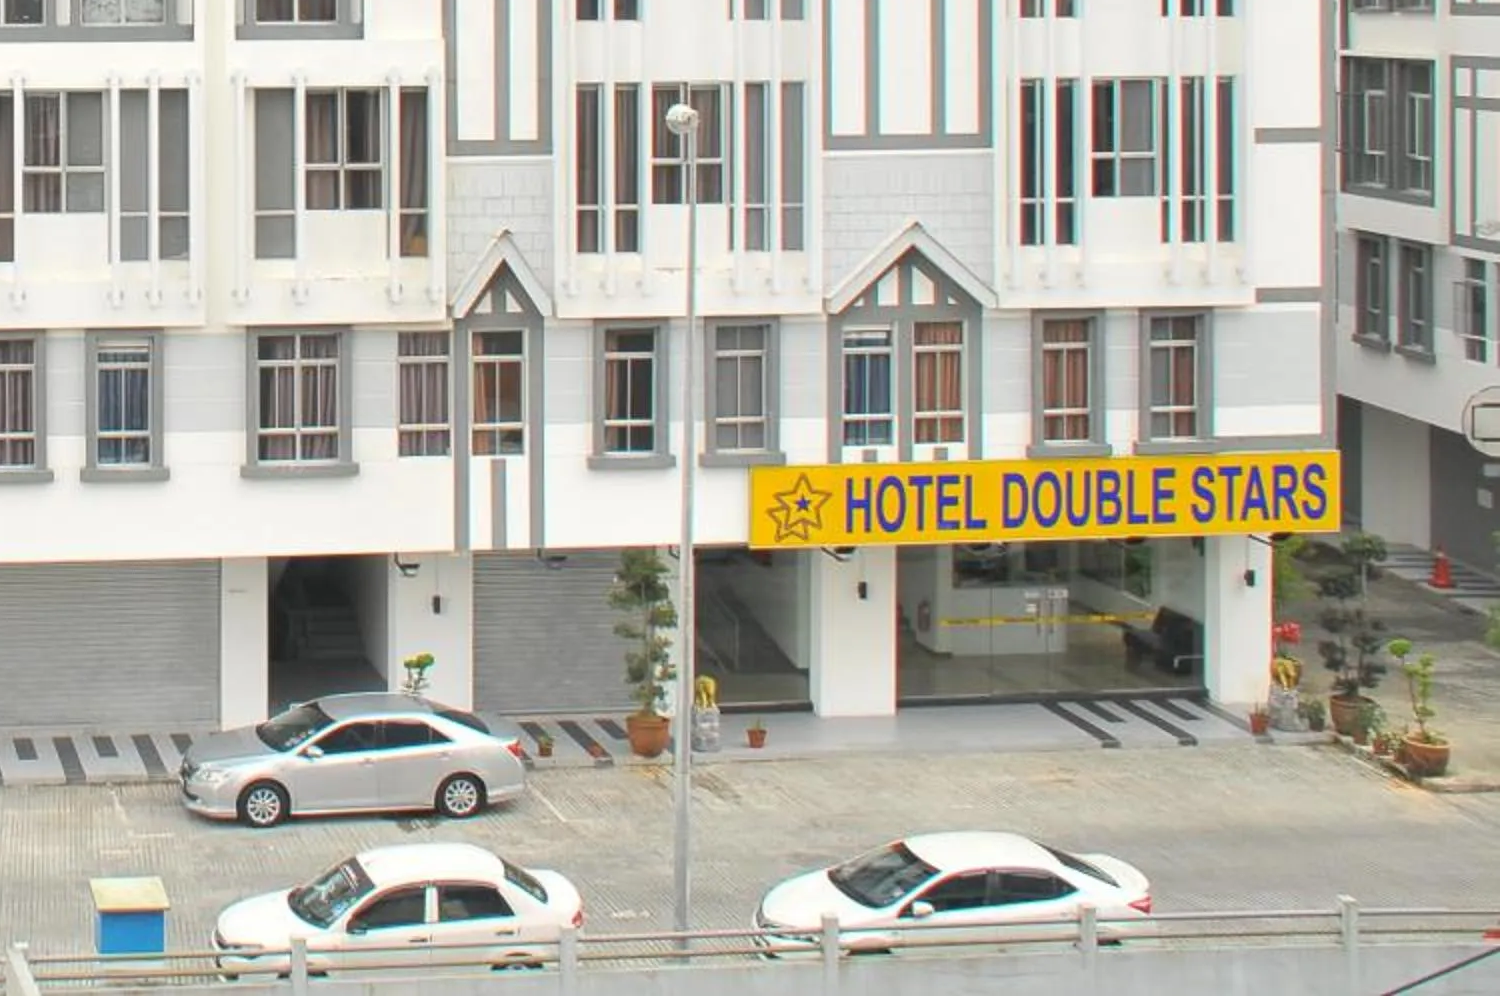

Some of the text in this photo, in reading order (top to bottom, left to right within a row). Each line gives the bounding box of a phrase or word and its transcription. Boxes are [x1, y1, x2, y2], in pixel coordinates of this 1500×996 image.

[845, 463, 1328, 534] HOTEL DOUBLE STARS
